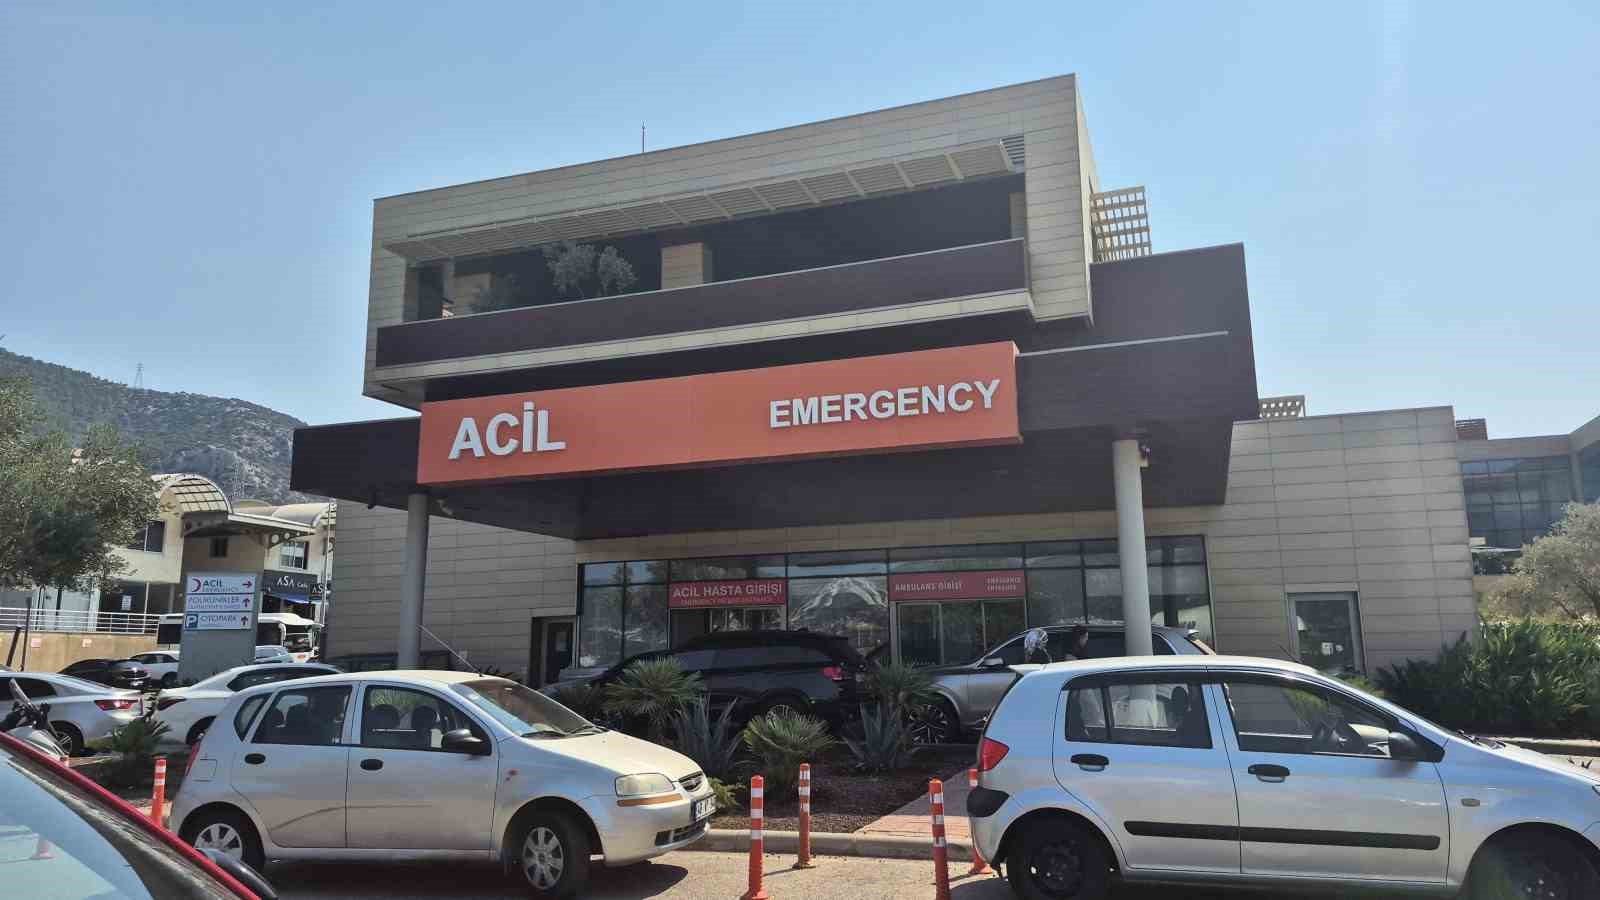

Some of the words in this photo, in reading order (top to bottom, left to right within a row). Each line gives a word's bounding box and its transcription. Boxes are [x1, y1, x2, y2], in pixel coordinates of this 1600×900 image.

[769, 379, 1001, 429] EMERGENCY
[447, 400, 567, 460] ACİL
[703, 584, 743, 597] HASTA
